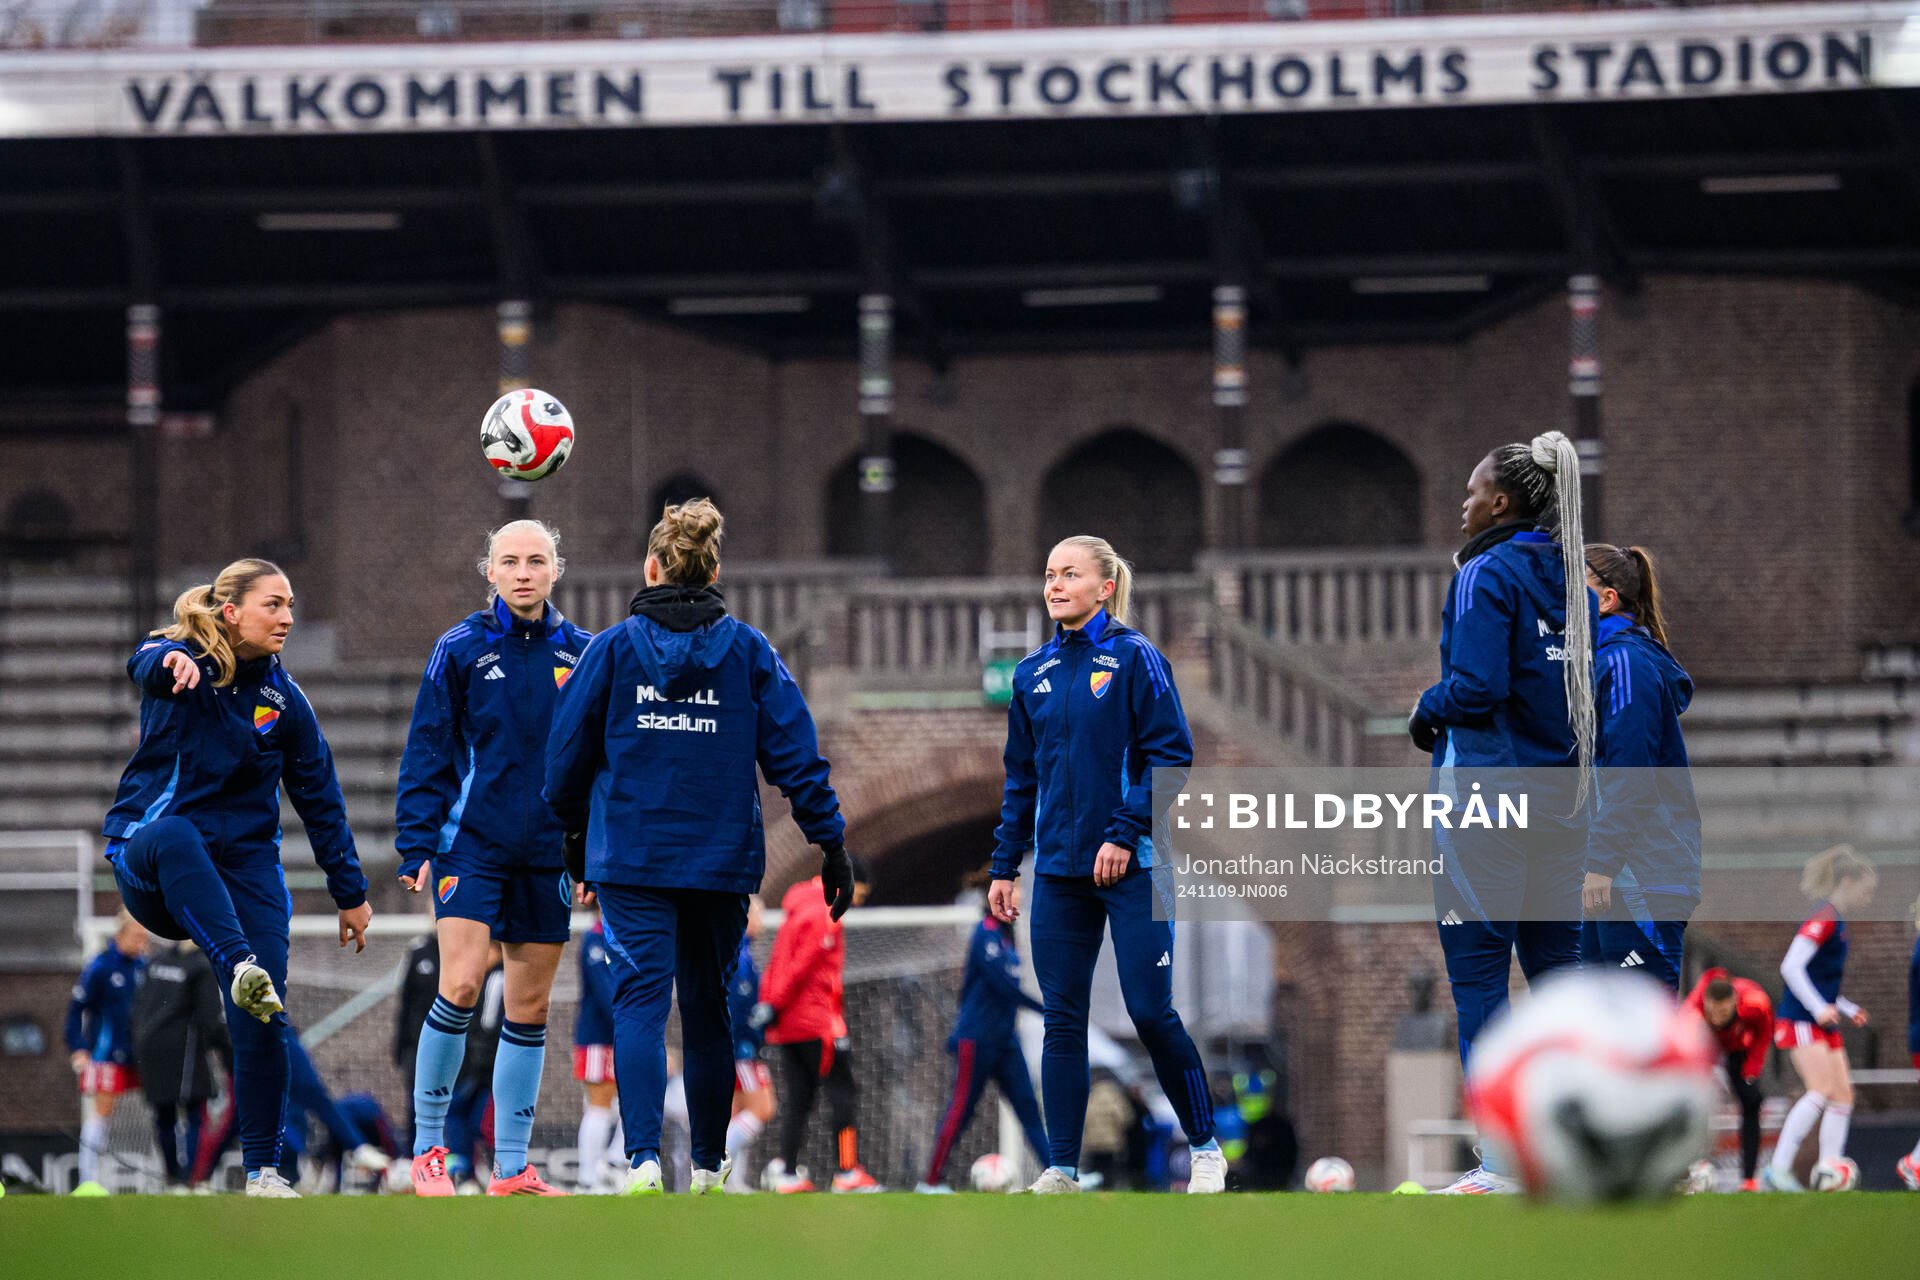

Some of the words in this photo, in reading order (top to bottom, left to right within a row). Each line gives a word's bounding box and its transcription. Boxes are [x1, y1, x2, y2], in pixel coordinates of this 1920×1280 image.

[126, 68, 645, 128] VÄLKOMMEN
[712, 65, 876, 114] TILL
[943, 48, 1469, 110] STOCKHOLMS
[1533, 33, 1872, 95] STADION
[637, 712, 716, 733] stadium
